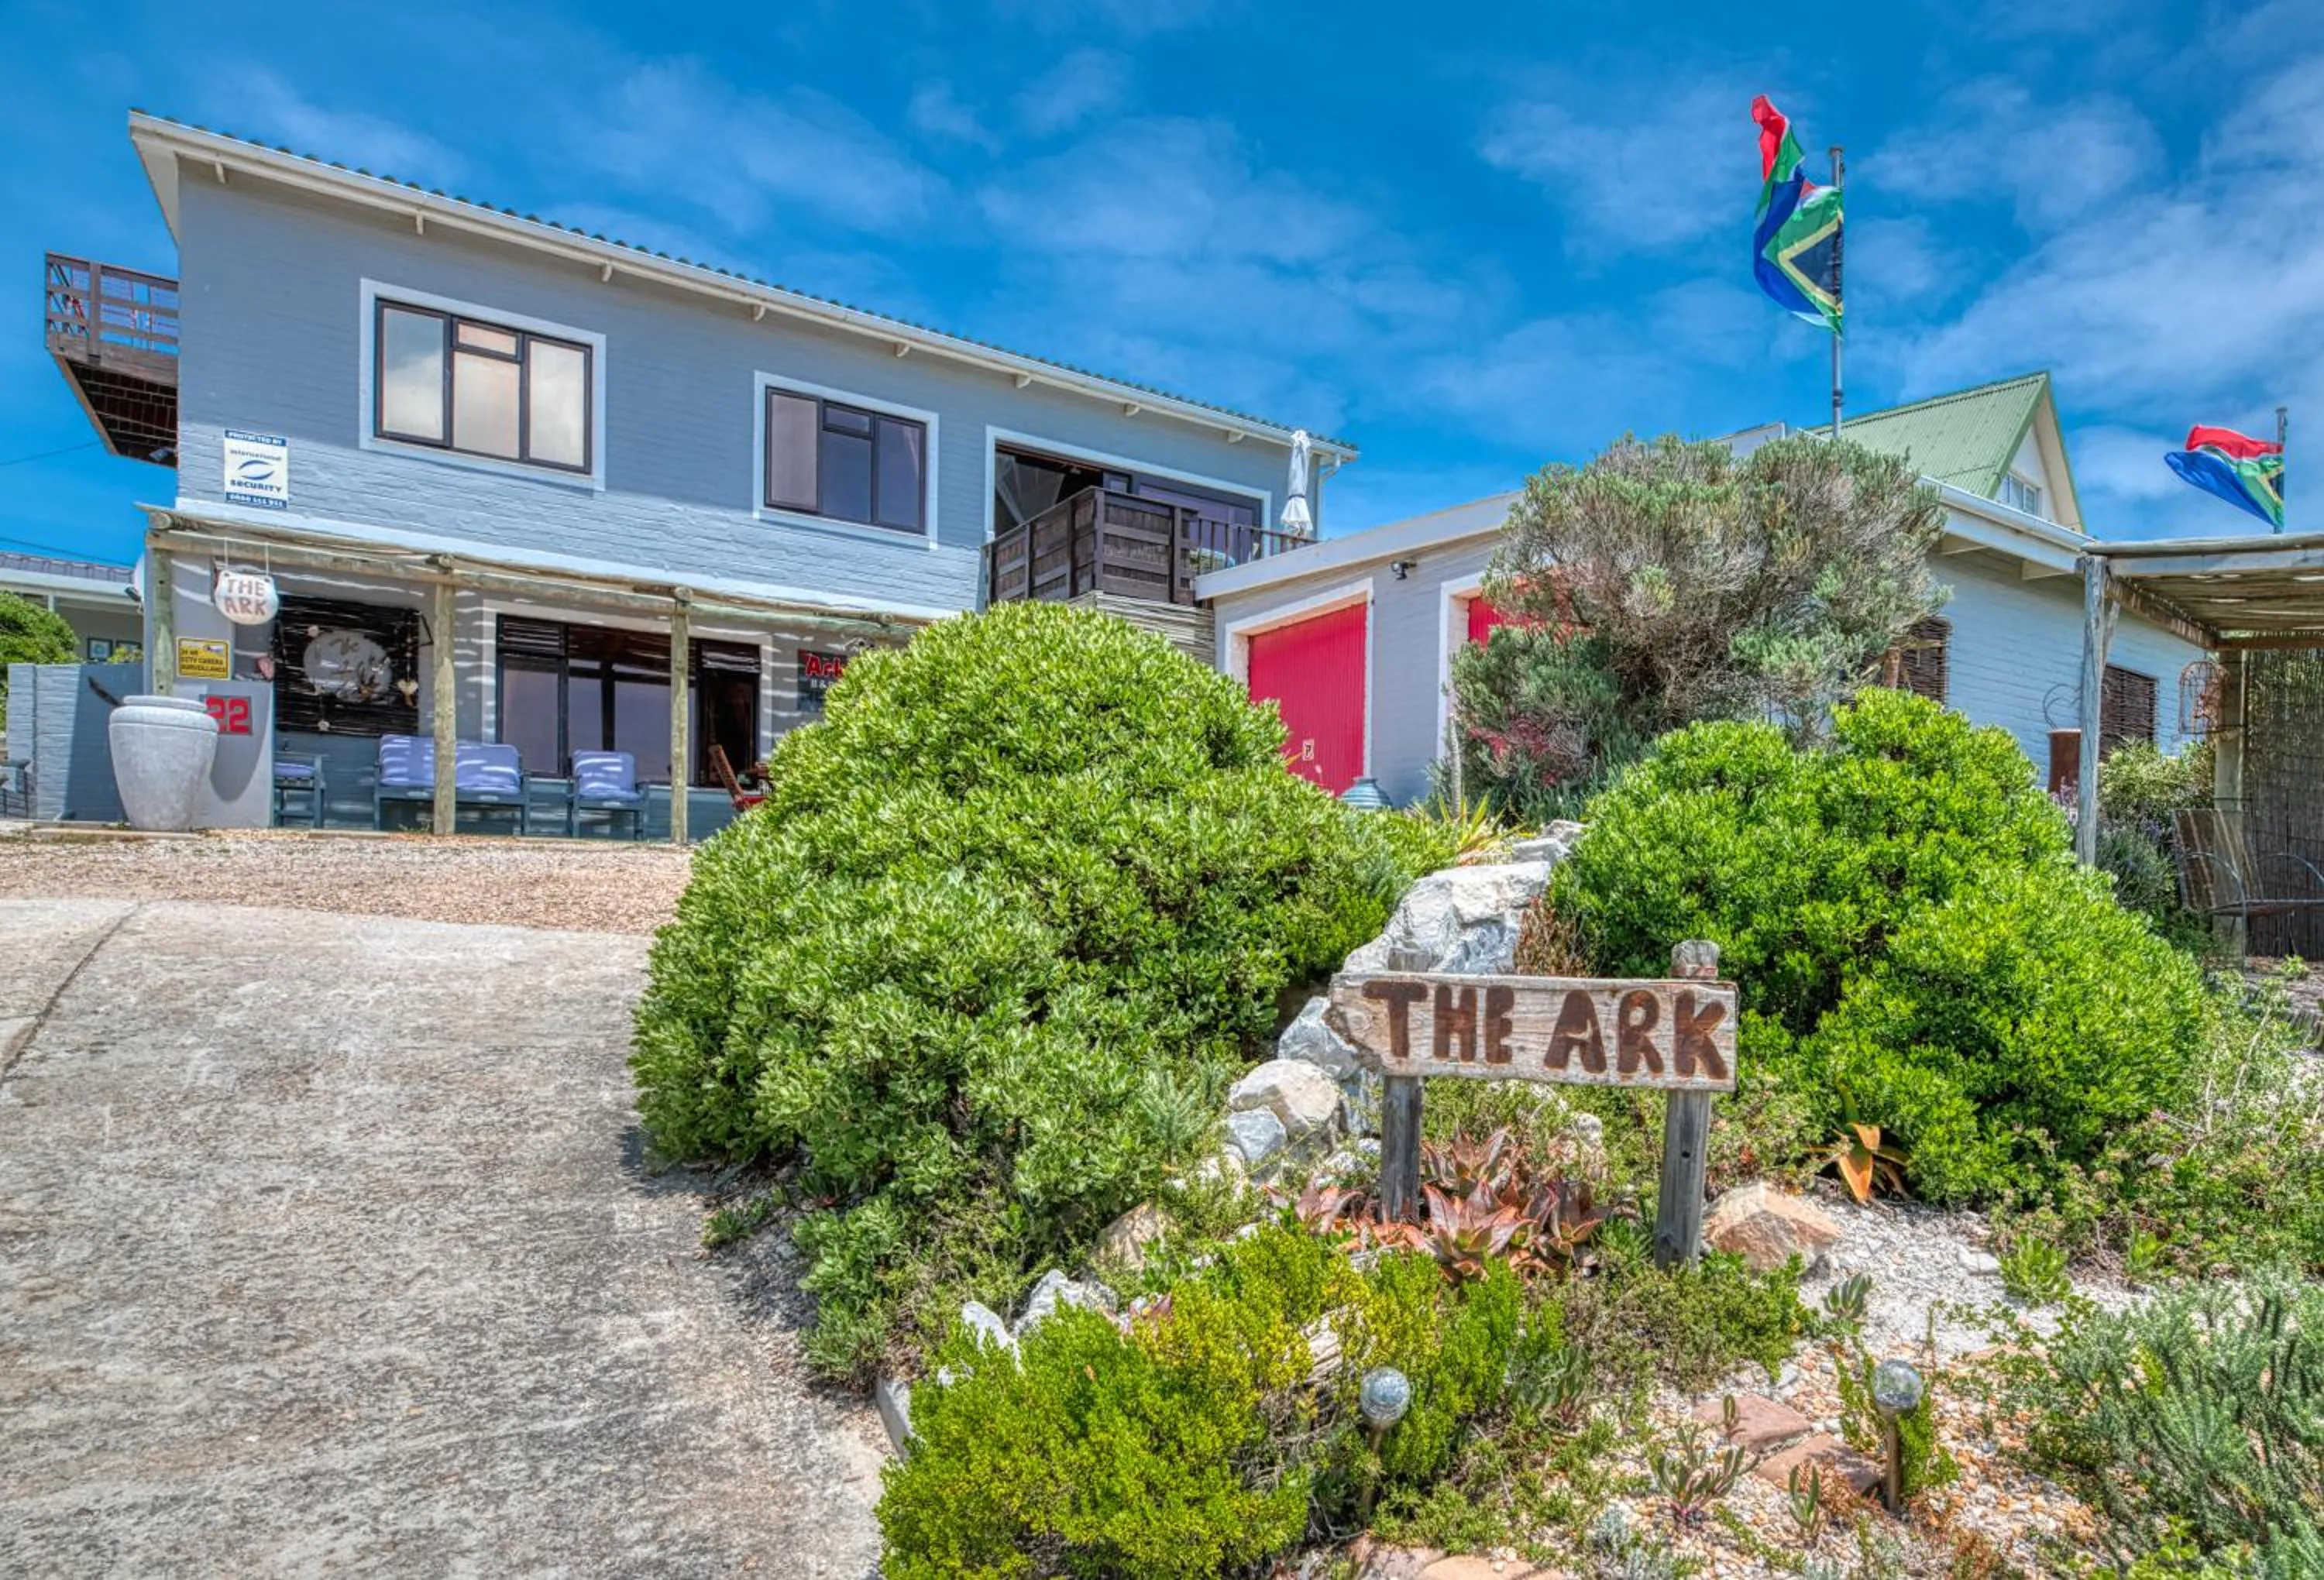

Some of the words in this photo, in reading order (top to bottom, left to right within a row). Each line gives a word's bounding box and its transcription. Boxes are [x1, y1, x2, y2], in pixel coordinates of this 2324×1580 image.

[228, 579, 265, 596] THE
[225, 596, 268, 617] ARK
[205, 696, 249, 733] 22
[1362, 981, 1514, 1065] THE
[1543, 988, 1729, 1080] ARK
